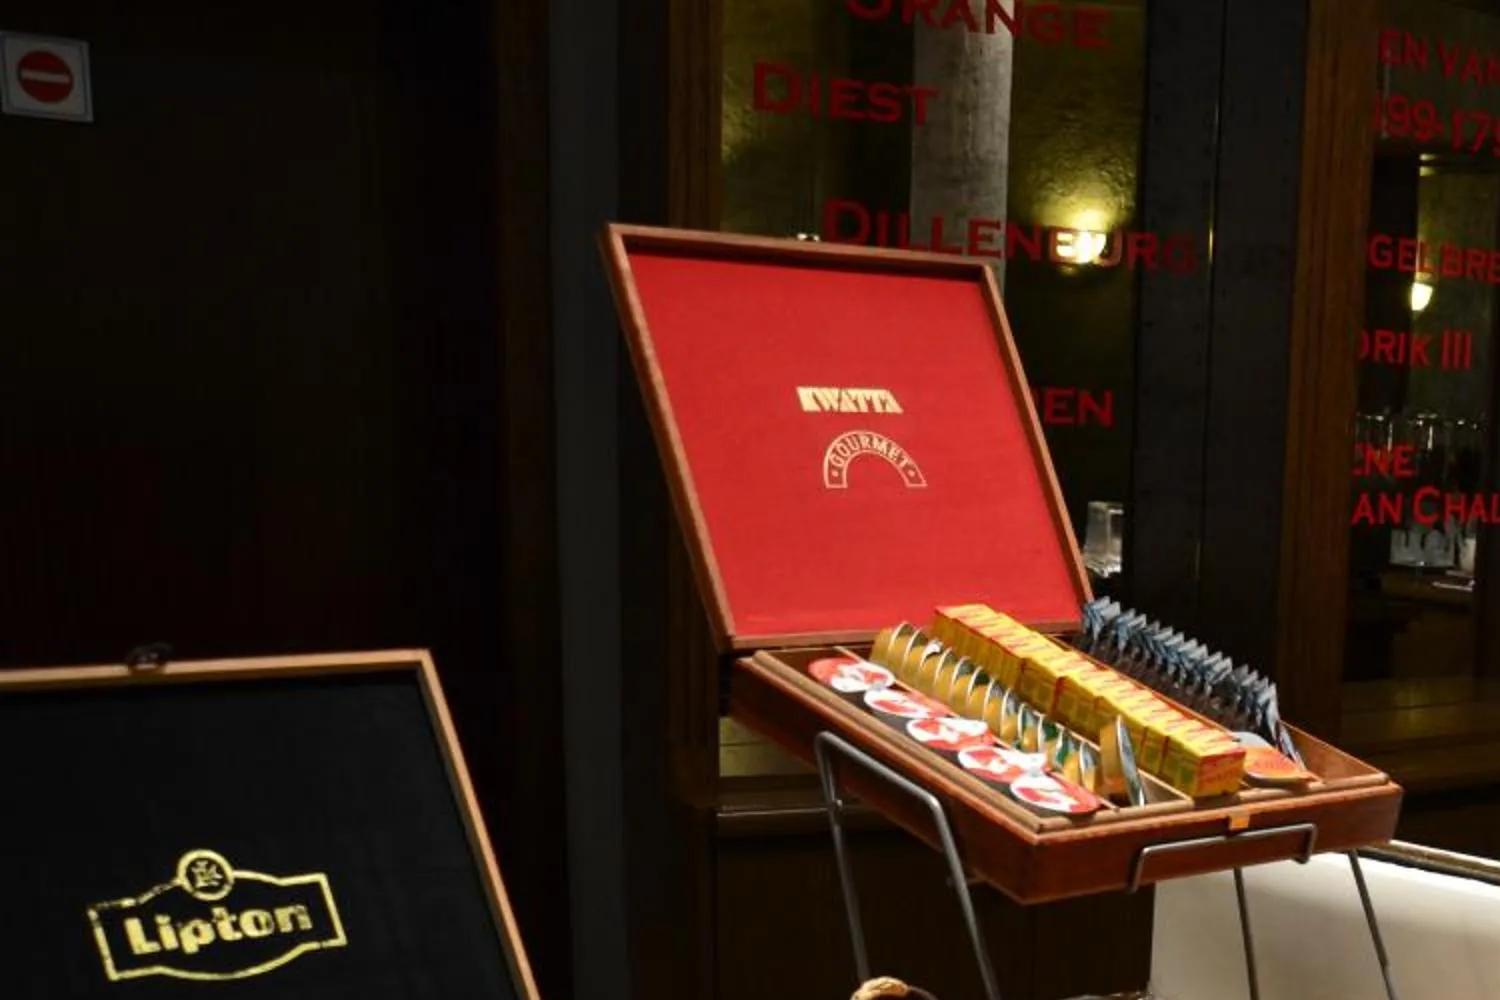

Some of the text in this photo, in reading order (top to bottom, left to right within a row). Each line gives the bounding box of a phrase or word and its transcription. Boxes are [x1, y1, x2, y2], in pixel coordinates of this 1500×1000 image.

[753, 62, 939, 127] DIEST
[796, 386, 904, 414] KWATTA
[1034, 386, 1118, 430] EN
[829, 434, 909, 468] GOURMET
[124, 905, 312, 954] Lipton
